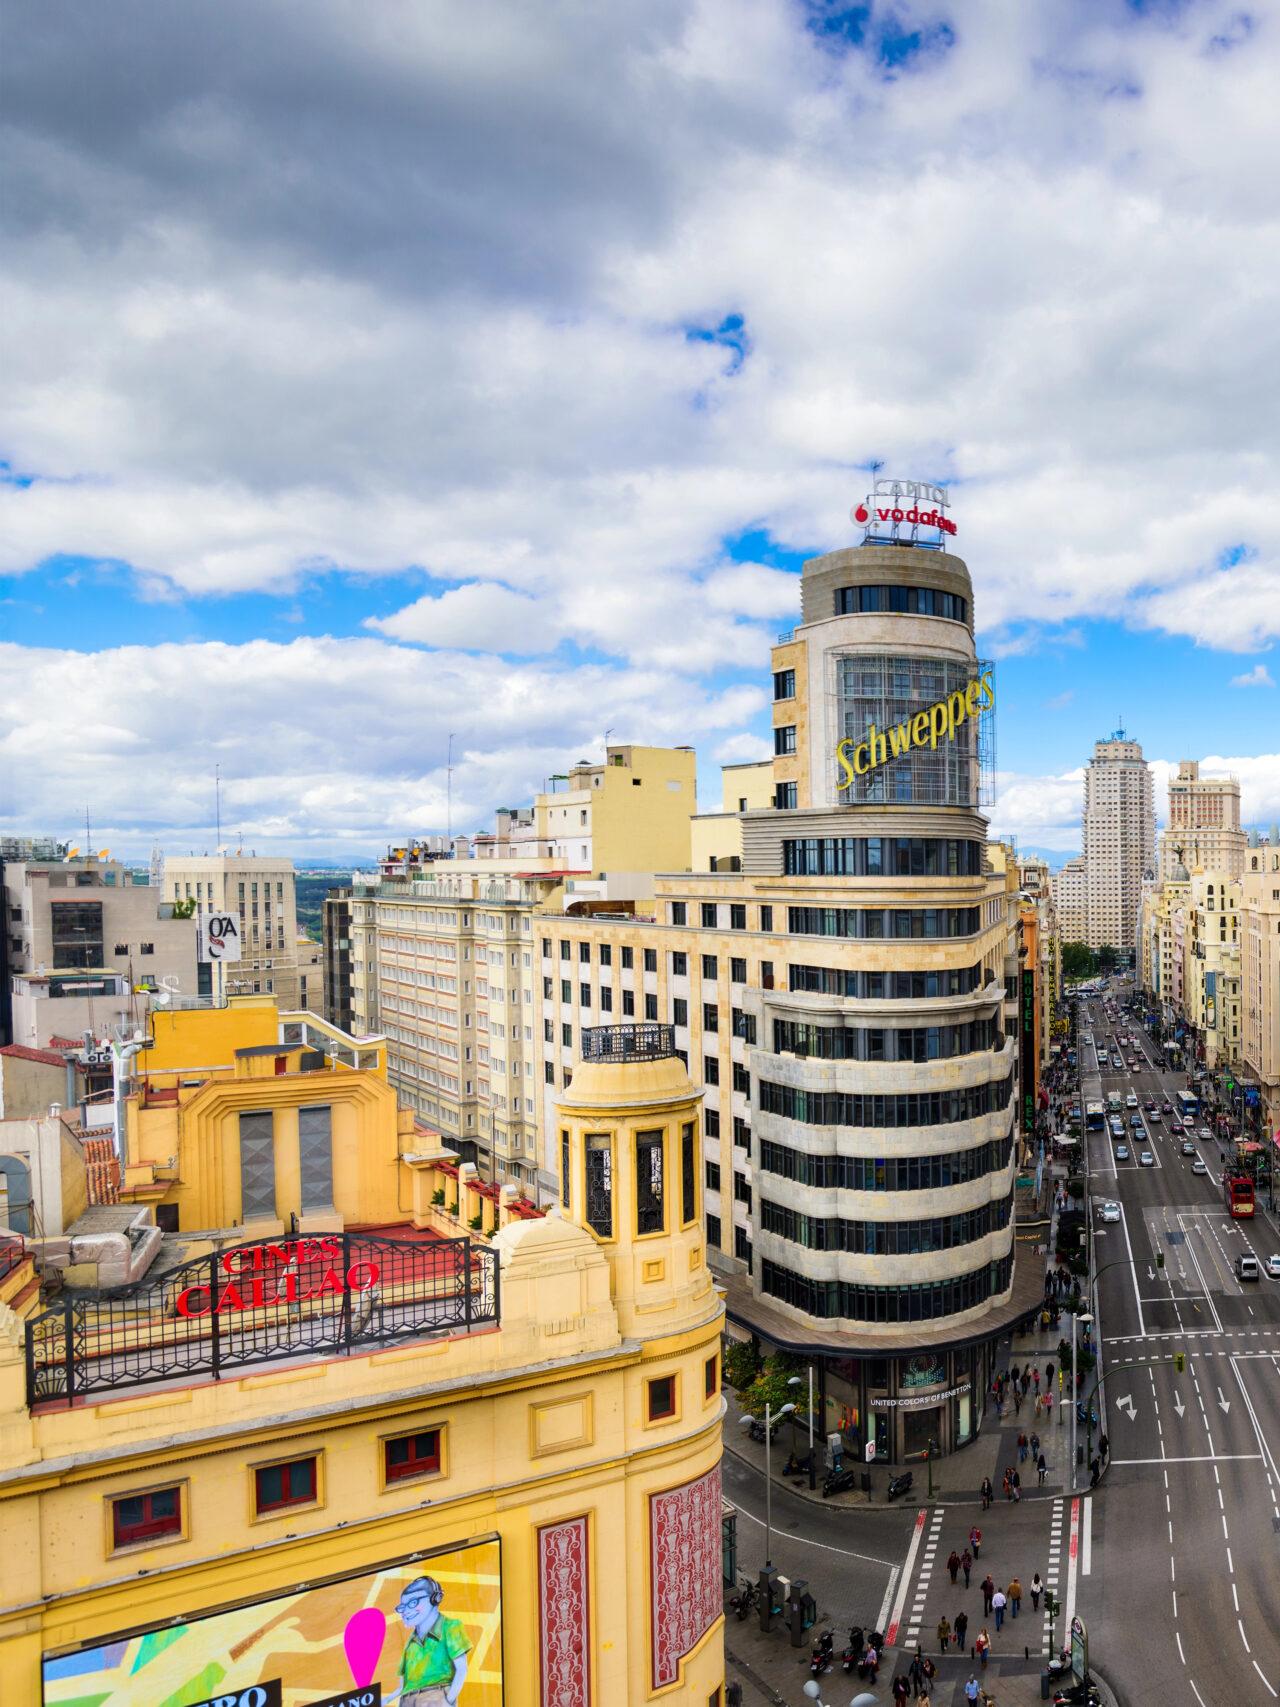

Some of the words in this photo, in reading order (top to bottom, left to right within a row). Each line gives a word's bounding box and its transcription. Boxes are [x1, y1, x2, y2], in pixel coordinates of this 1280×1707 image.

[877, 506, 957, 534] vodafone
[836, 671, 995, 790] Schweppes
[1024, 974, 1032, 1032] HOTEL
[1025, 1095, 1033, 1129] REX
[222, 1235, 339, 1275] CINES
[176, 1260, 380, 1318] CALLAO
[898, 1397, 930, 1406] COLORS
[930, 1394, 941, 1402] OF
[940, 1383, 972, 1400] BENETTON
